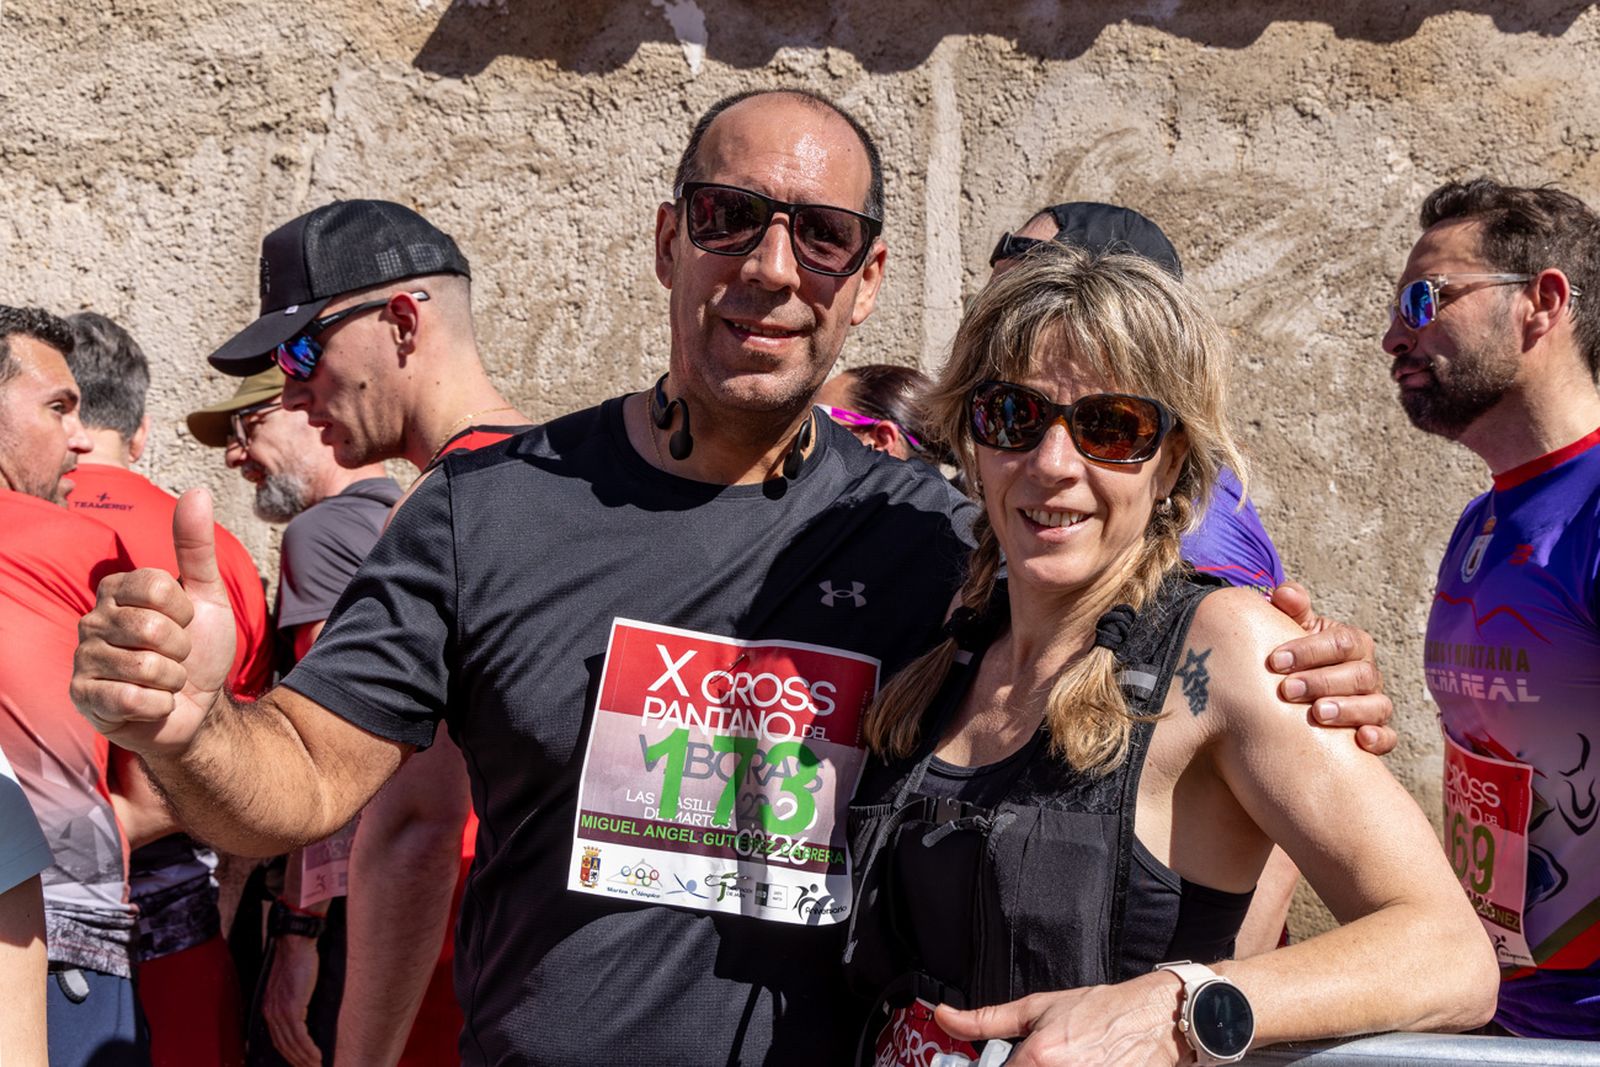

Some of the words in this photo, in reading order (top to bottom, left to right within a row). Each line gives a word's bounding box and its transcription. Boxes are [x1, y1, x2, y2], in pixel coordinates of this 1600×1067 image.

[647, 643, 698, 697] X
[701, 670, 837, 716] CROSS
[1460, 672, 1541, 704] REAL
[641, 696, 796, 743] PANTANO
[801, 723, 831, 742] DEL
[626, 789, 656, 805] LAS
[646, 728, 826, 835] 173
[580, 814, 641, 837] MIGUEL
[643, 824, 699, 846] ANGEL
[767, 833, 809, 865] 26
[896, 1023, 943, 1067] CRO
